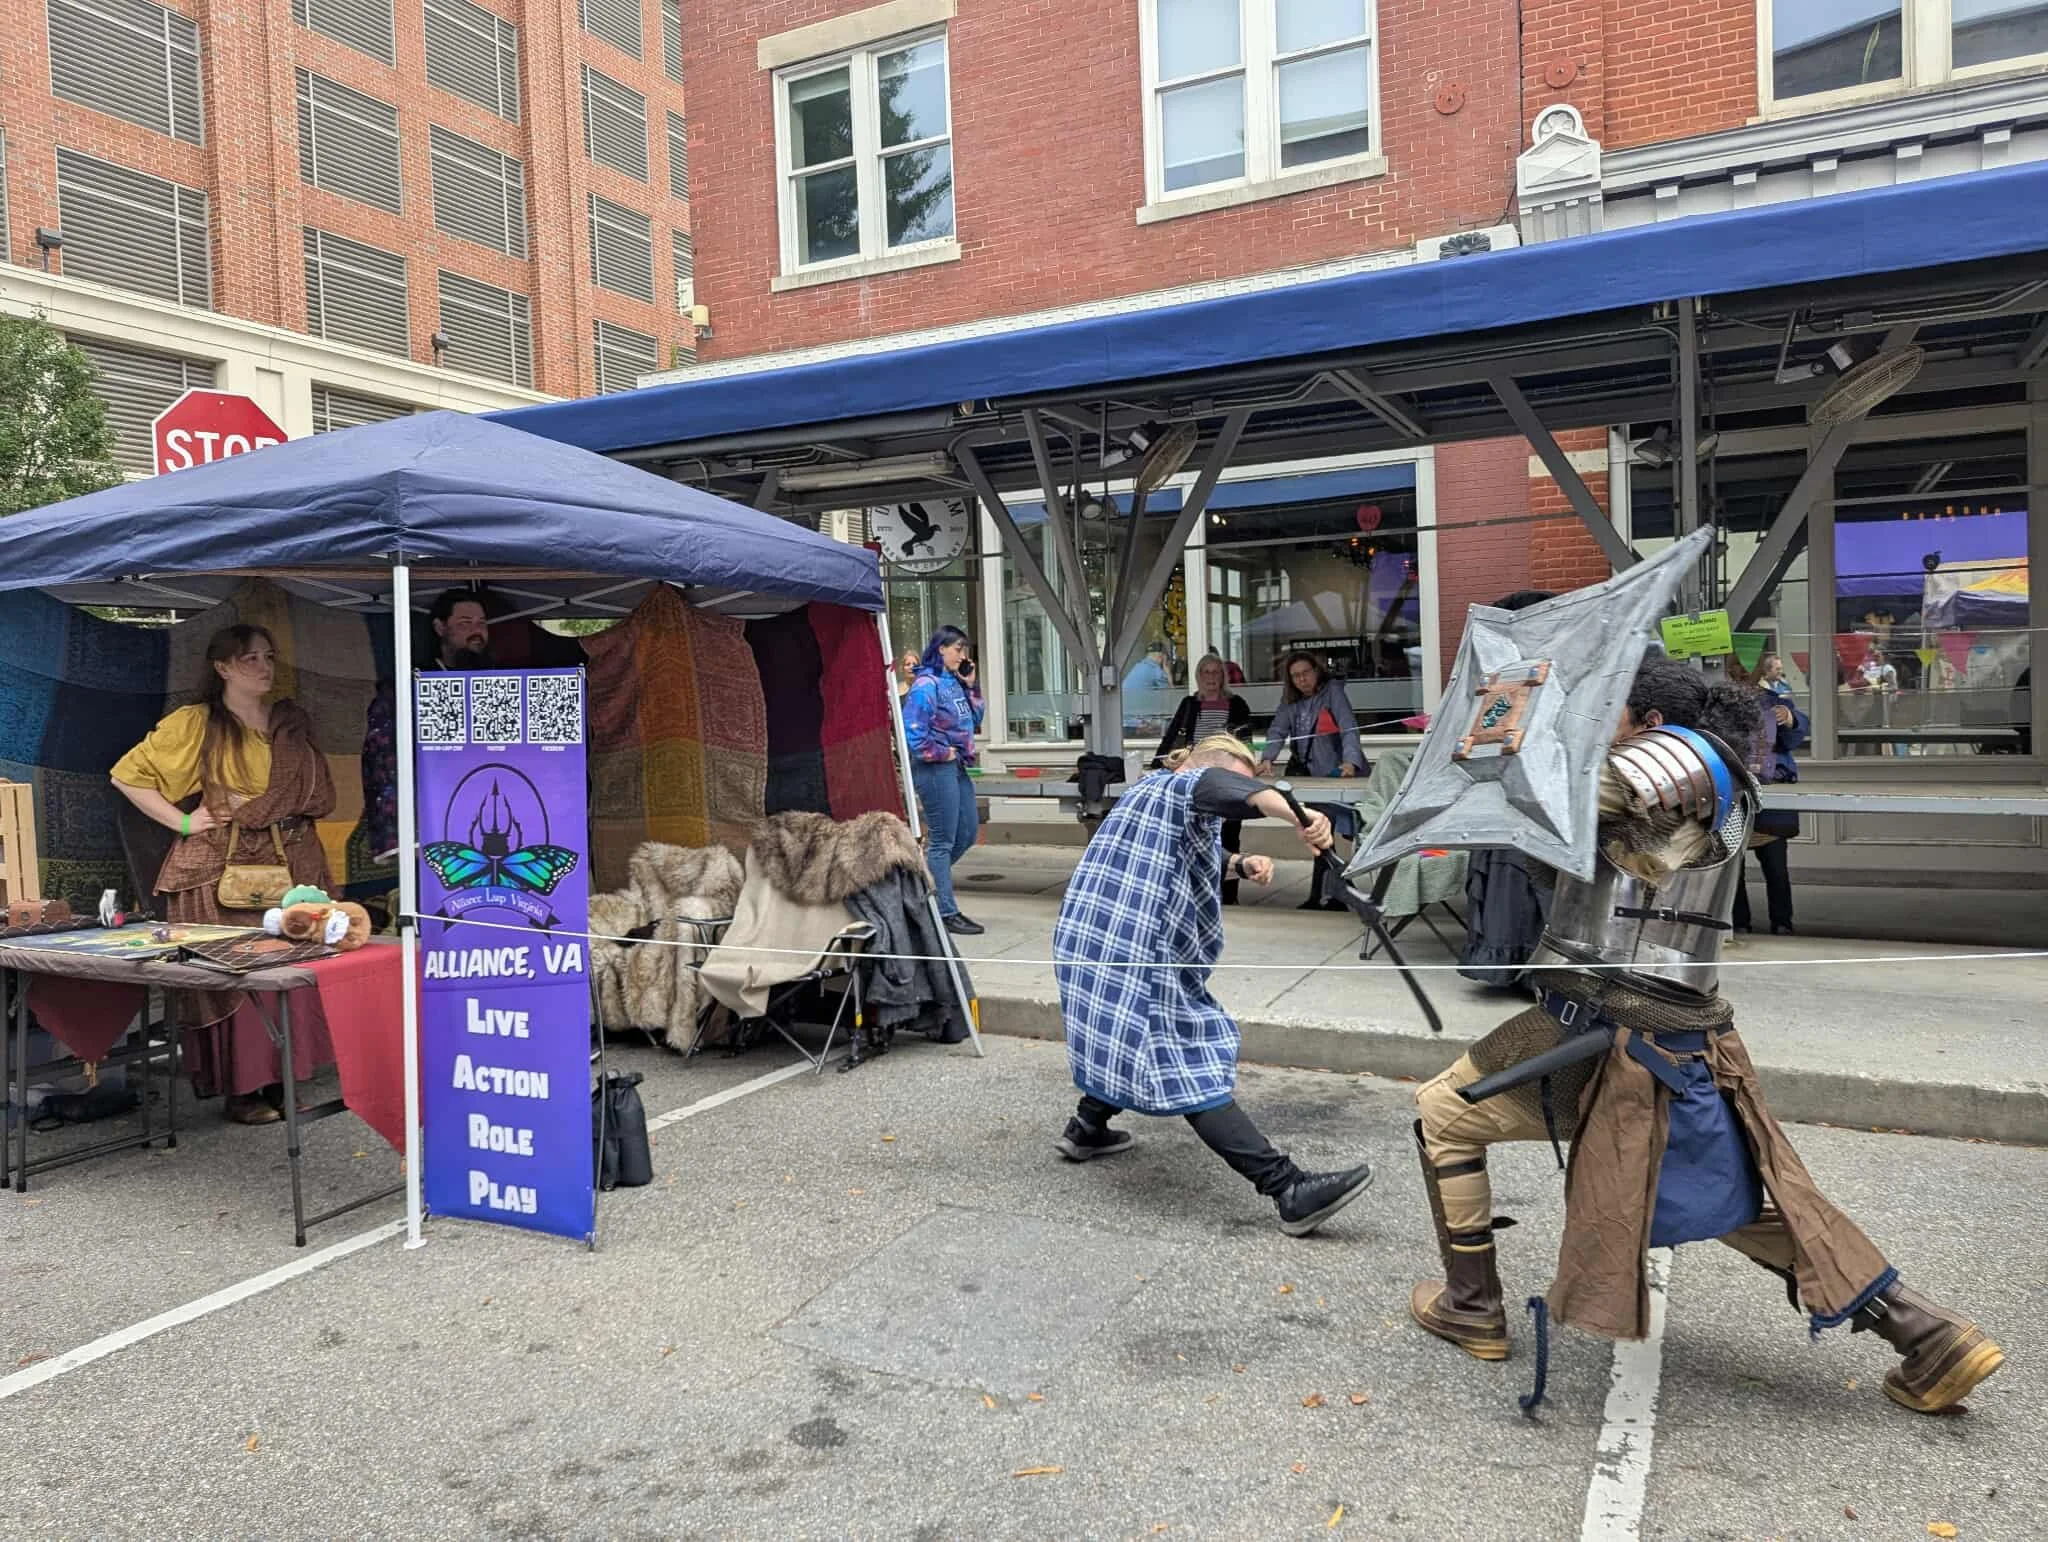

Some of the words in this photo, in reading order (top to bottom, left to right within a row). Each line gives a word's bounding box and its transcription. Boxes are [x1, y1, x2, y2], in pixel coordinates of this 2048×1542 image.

[485, 888, 507, 905] Larp
[511, 893, 543, 917] Virginia
[424, 946, 536, 979] ALLIANCE,
[543, 943, 584, 974] VA
